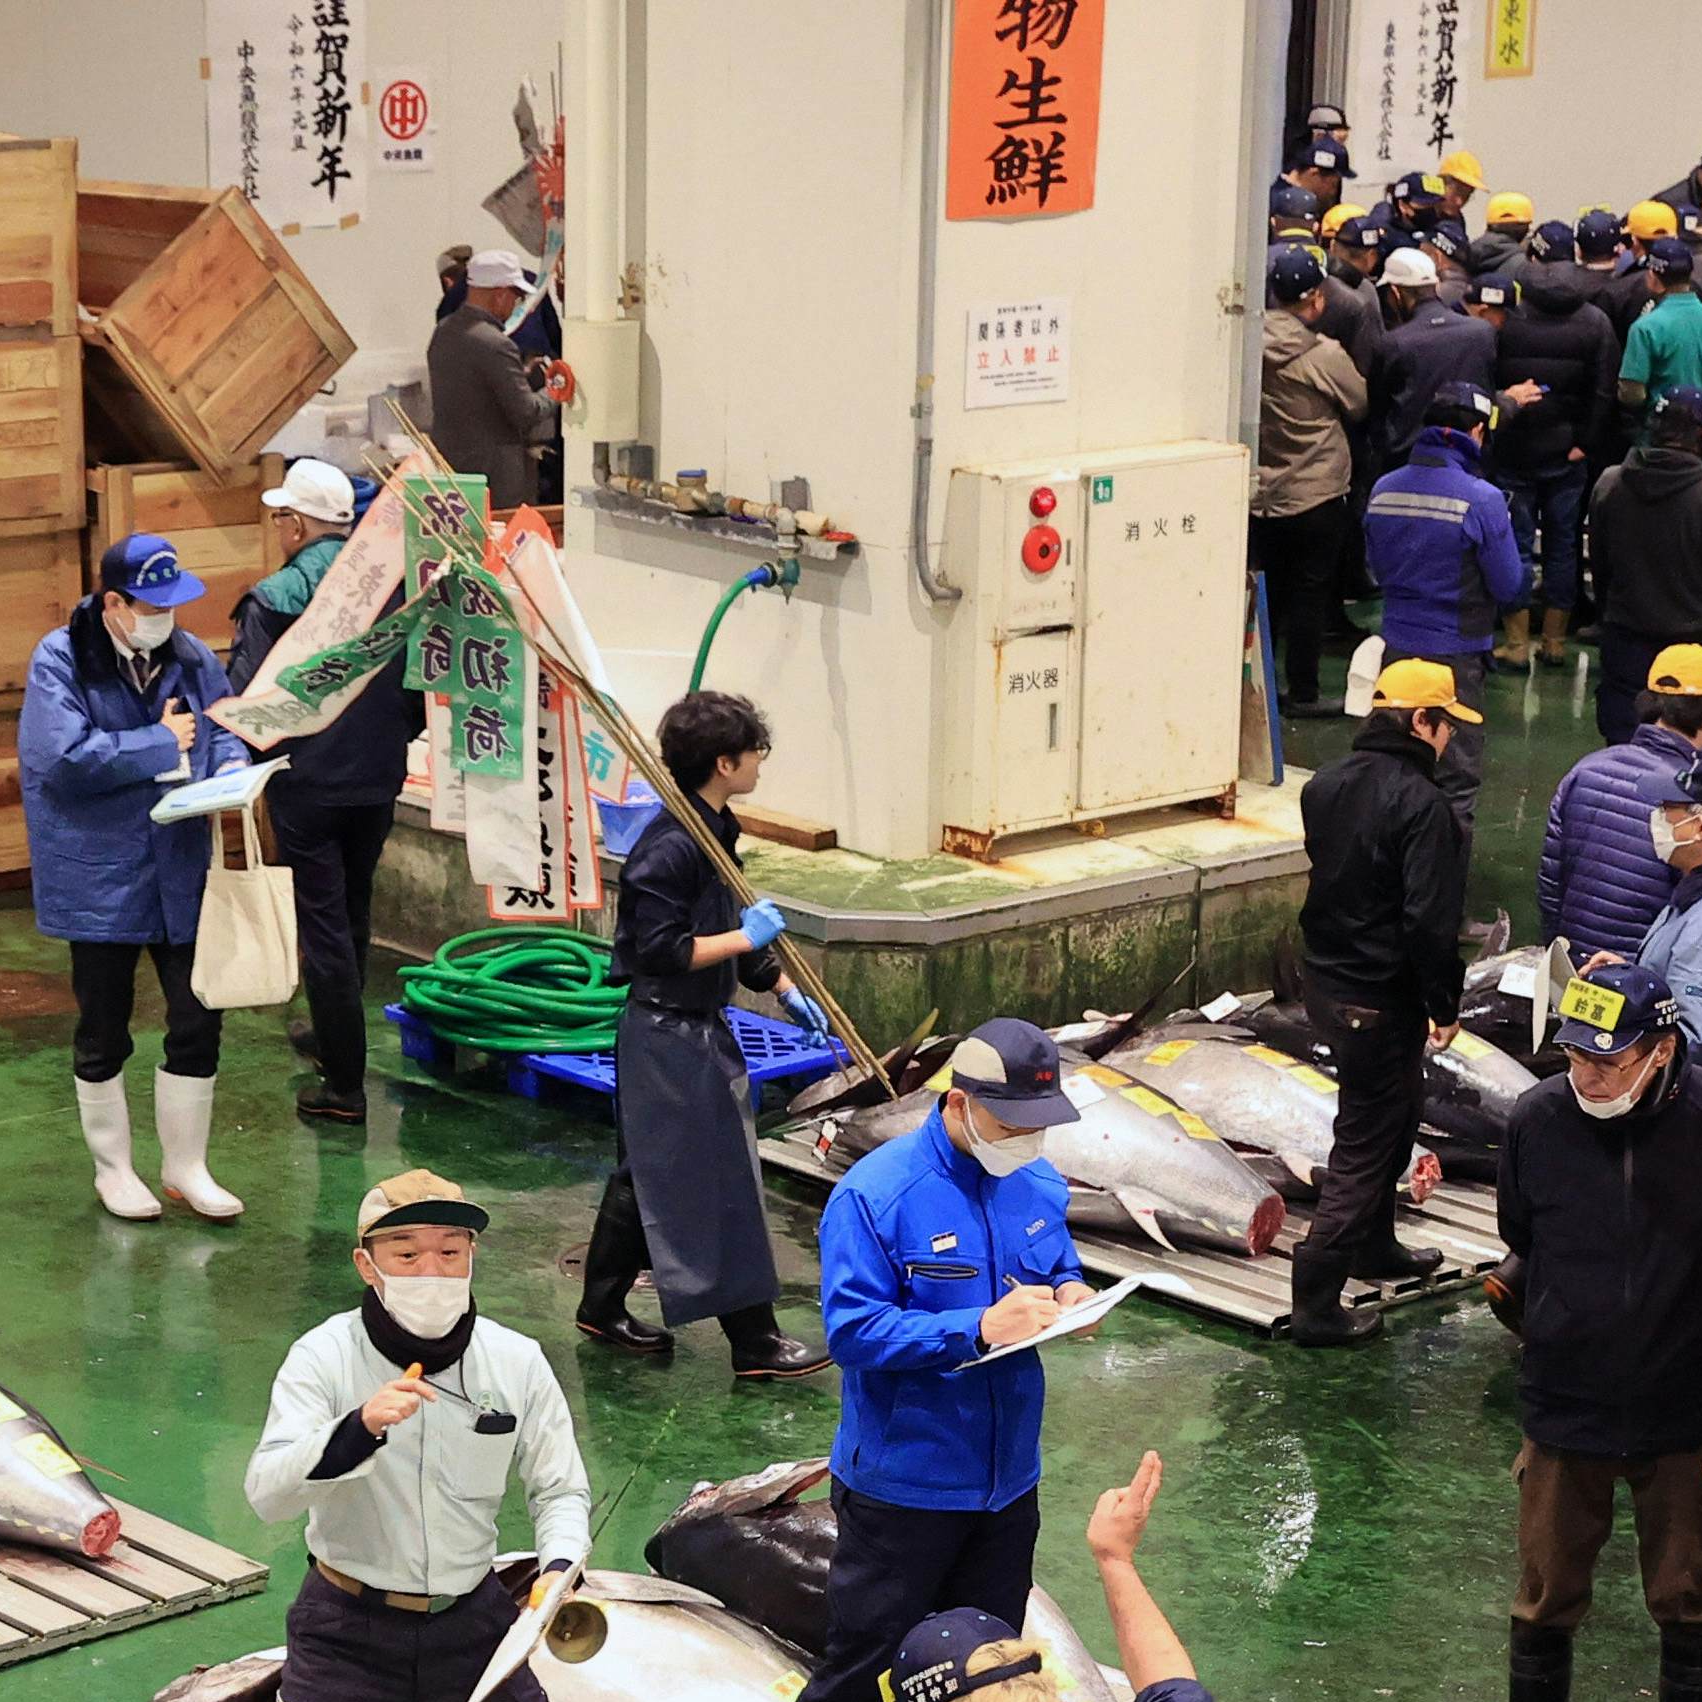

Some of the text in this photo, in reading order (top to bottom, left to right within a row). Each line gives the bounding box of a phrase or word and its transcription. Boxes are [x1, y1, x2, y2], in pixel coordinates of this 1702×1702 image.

[984, 0, 1079, 209] 物生鮮
[978, 317, 1059, 341] 関係者以外
[976, 346, 1060, 369] 立入禁止
[1124, 513, 1196, 542] 消火栓
[1007, 667, 1059, 695] 消火器
